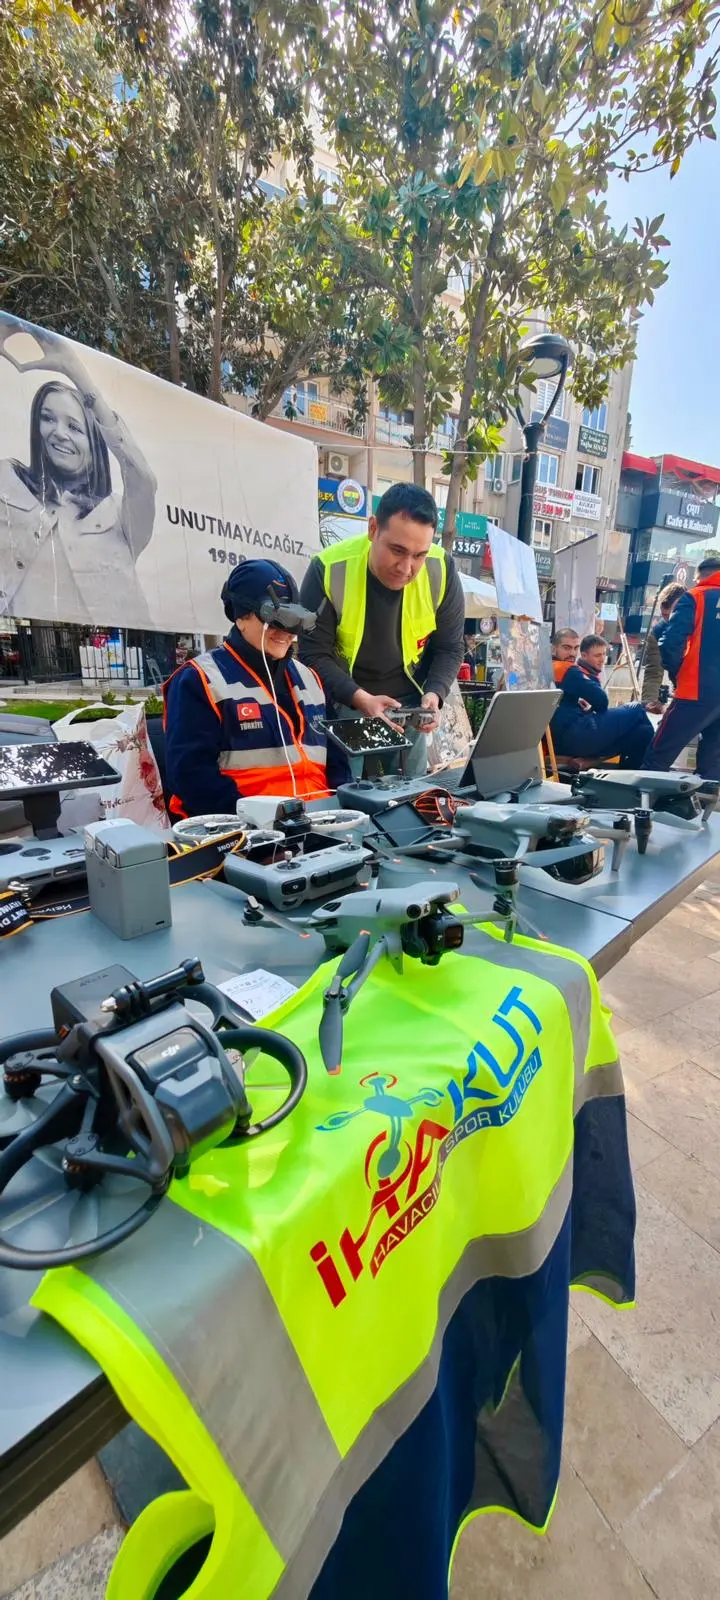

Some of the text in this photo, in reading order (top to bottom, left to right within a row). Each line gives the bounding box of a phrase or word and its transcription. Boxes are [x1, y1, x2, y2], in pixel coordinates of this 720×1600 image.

[666, 514, 683, 528] Cafe
[535, 552, 551, 565] lleza
[240, 721, 263, 731] TÜRKİYE
[160, 1044, 180, 1058] dji
[444, 1111, 492, 1153] SPOR
[498, 1054, 539, 1125] KULÜBÜ
